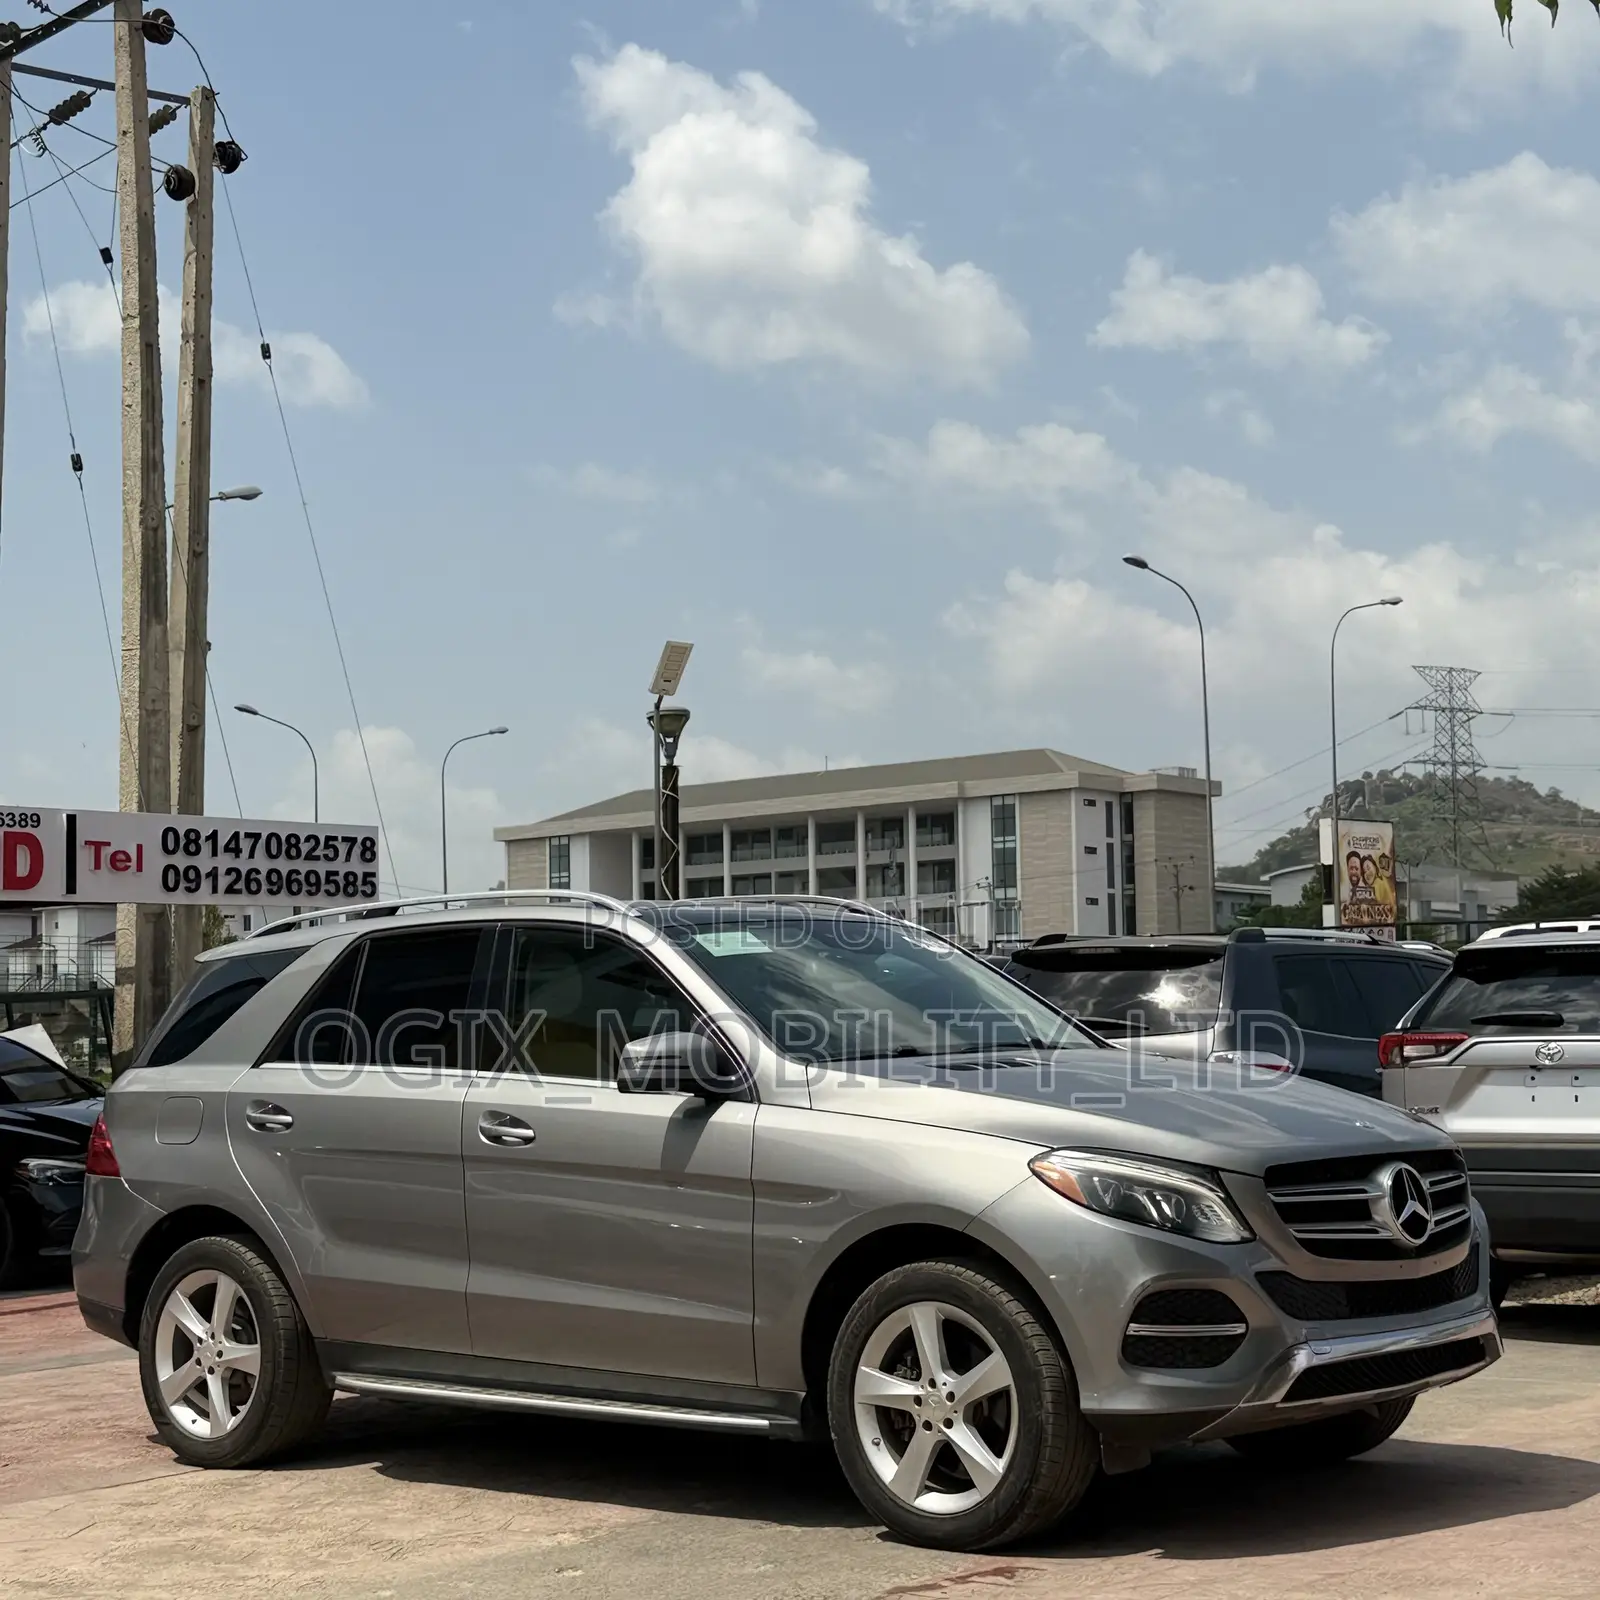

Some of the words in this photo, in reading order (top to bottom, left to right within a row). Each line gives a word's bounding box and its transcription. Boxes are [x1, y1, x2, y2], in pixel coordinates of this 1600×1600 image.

[3, 831, 44, 890] D
[85, 840, 143, 873] Tel
[161, 826, 377, 863] 08147082578
[161, 864, 377, 898] 09126969585
